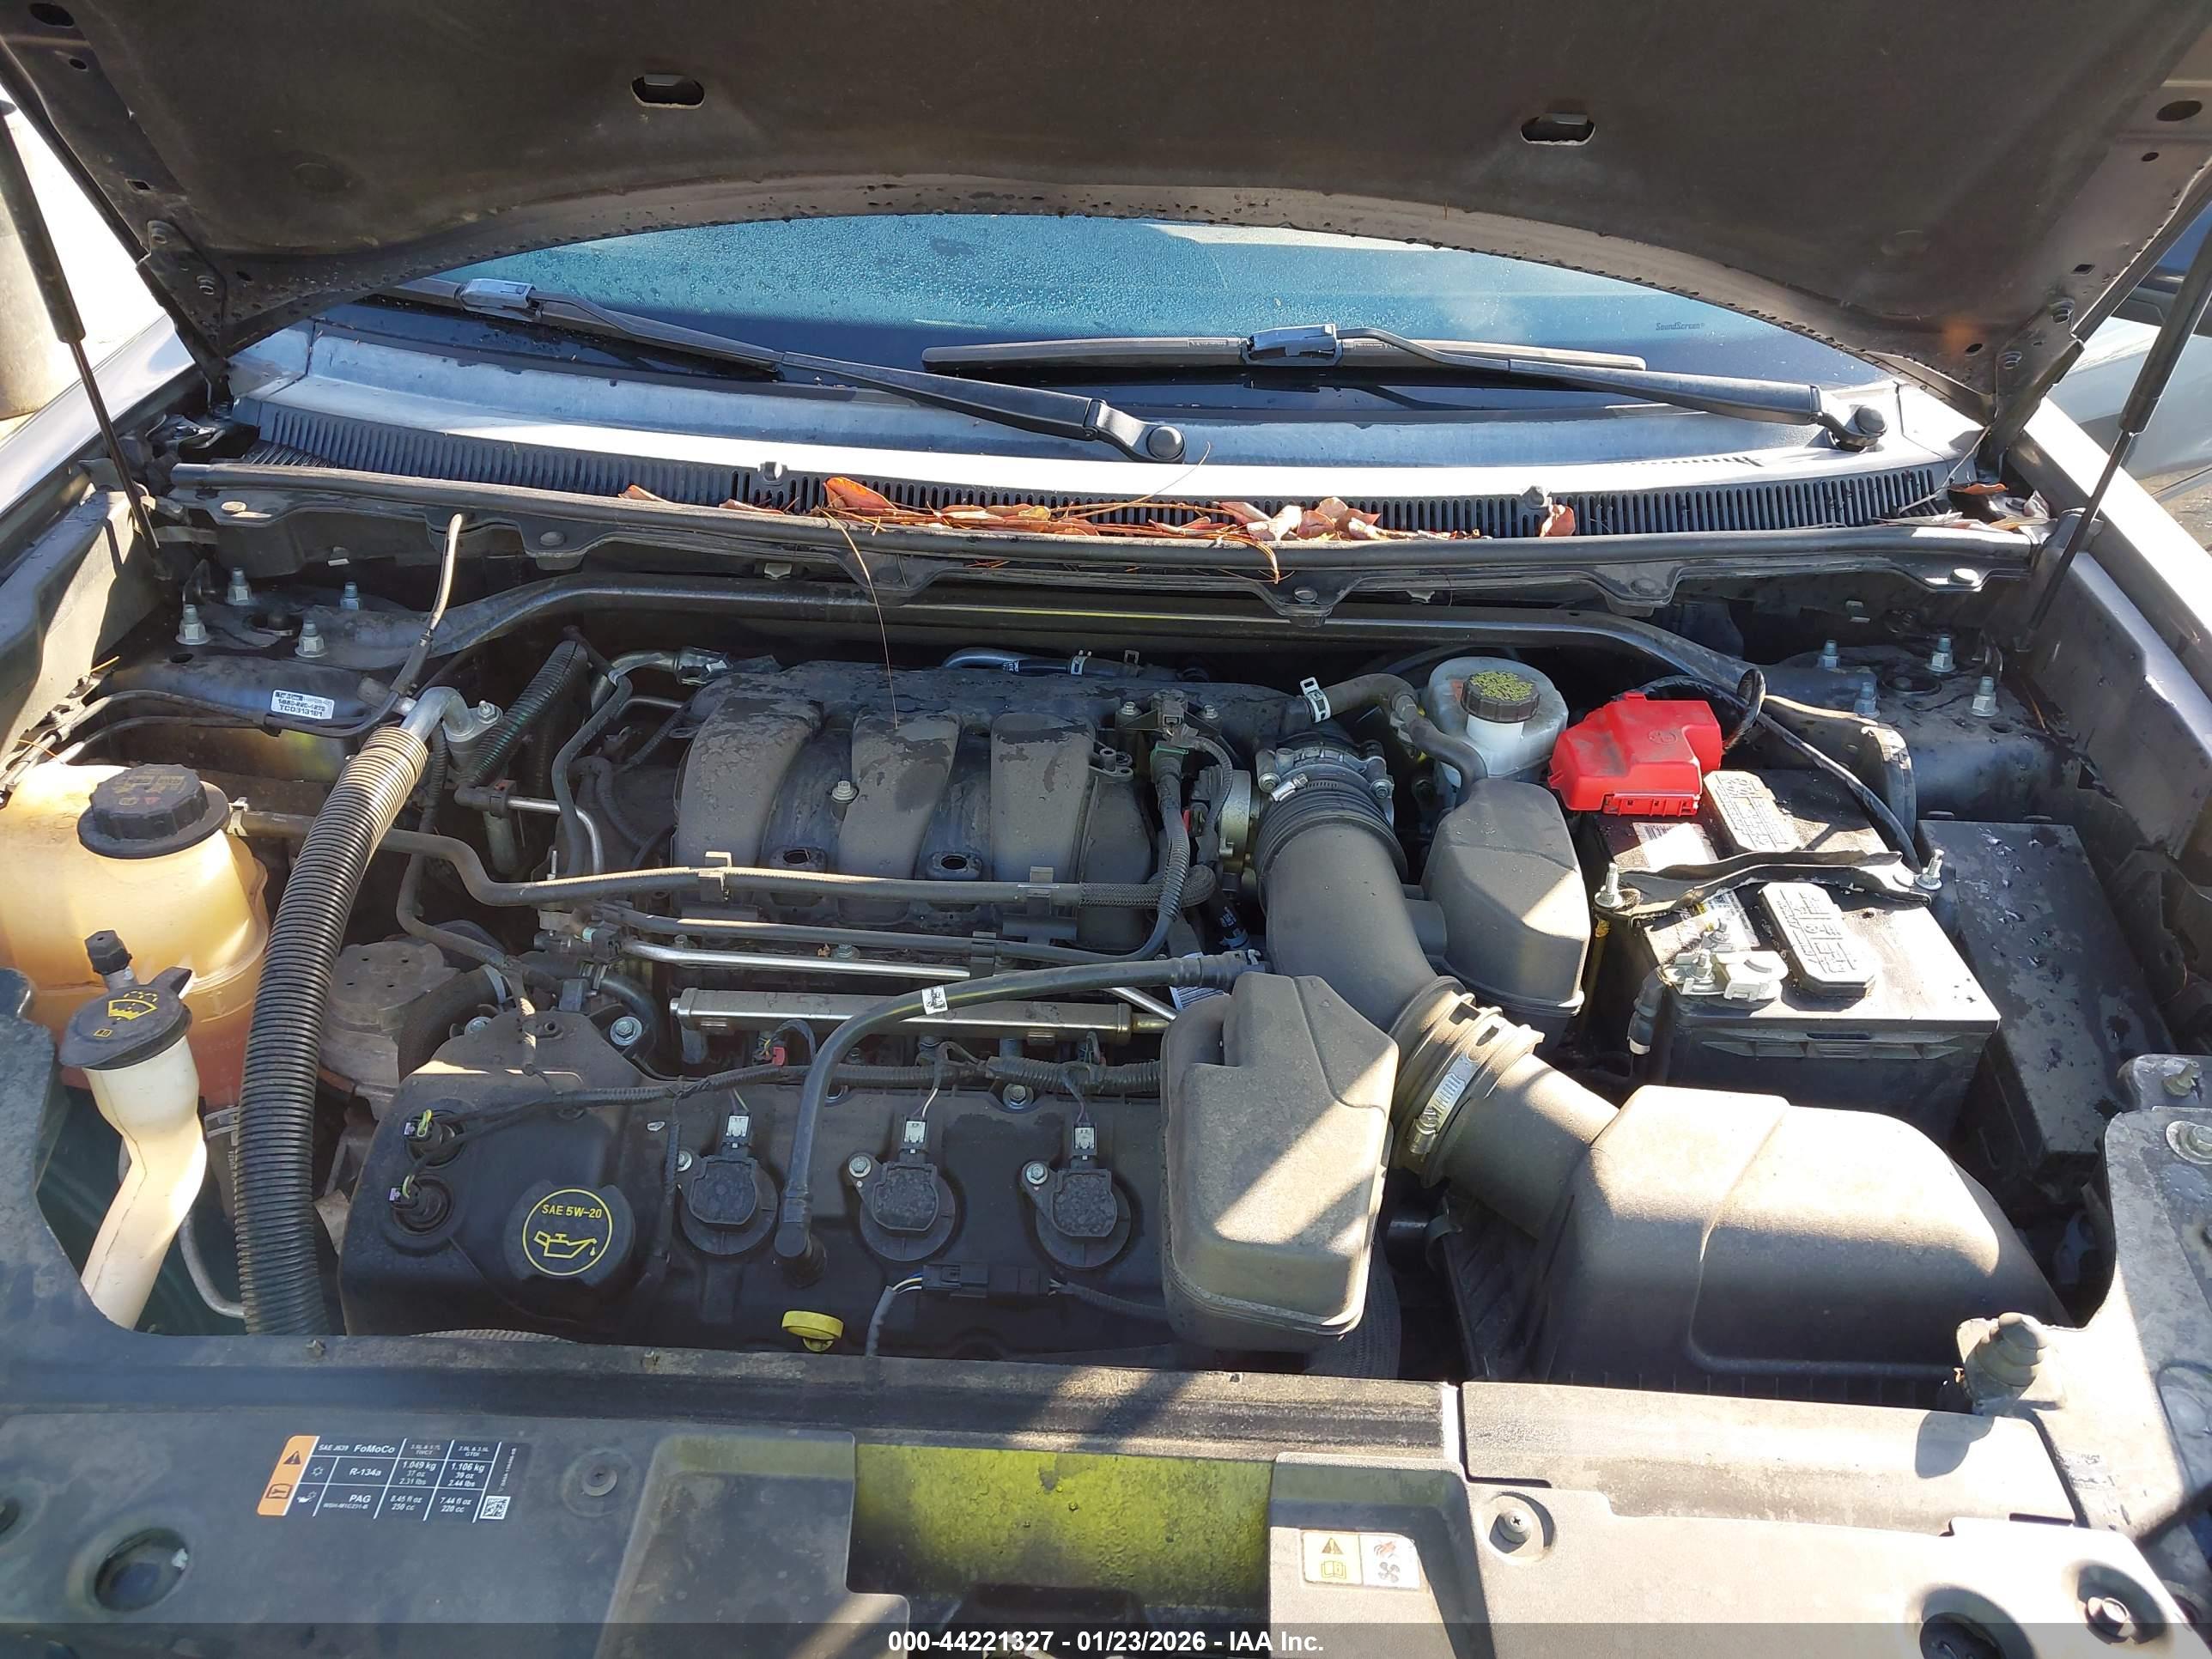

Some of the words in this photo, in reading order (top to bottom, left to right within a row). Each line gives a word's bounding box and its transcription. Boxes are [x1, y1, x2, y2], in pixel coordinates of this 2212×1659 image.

[542, 1204, 564, 1216] SAE
[565, 1206, 602, 1218] 5W-20
[353, 1443, 395, 1454] FoMoCo
[349, 1468, 381, 1476] R-134a
[425, 1462, 437, 1472] kg
[474, 1463, 485, 1474] kg
[349, 1494, 371, 1503] PAG
